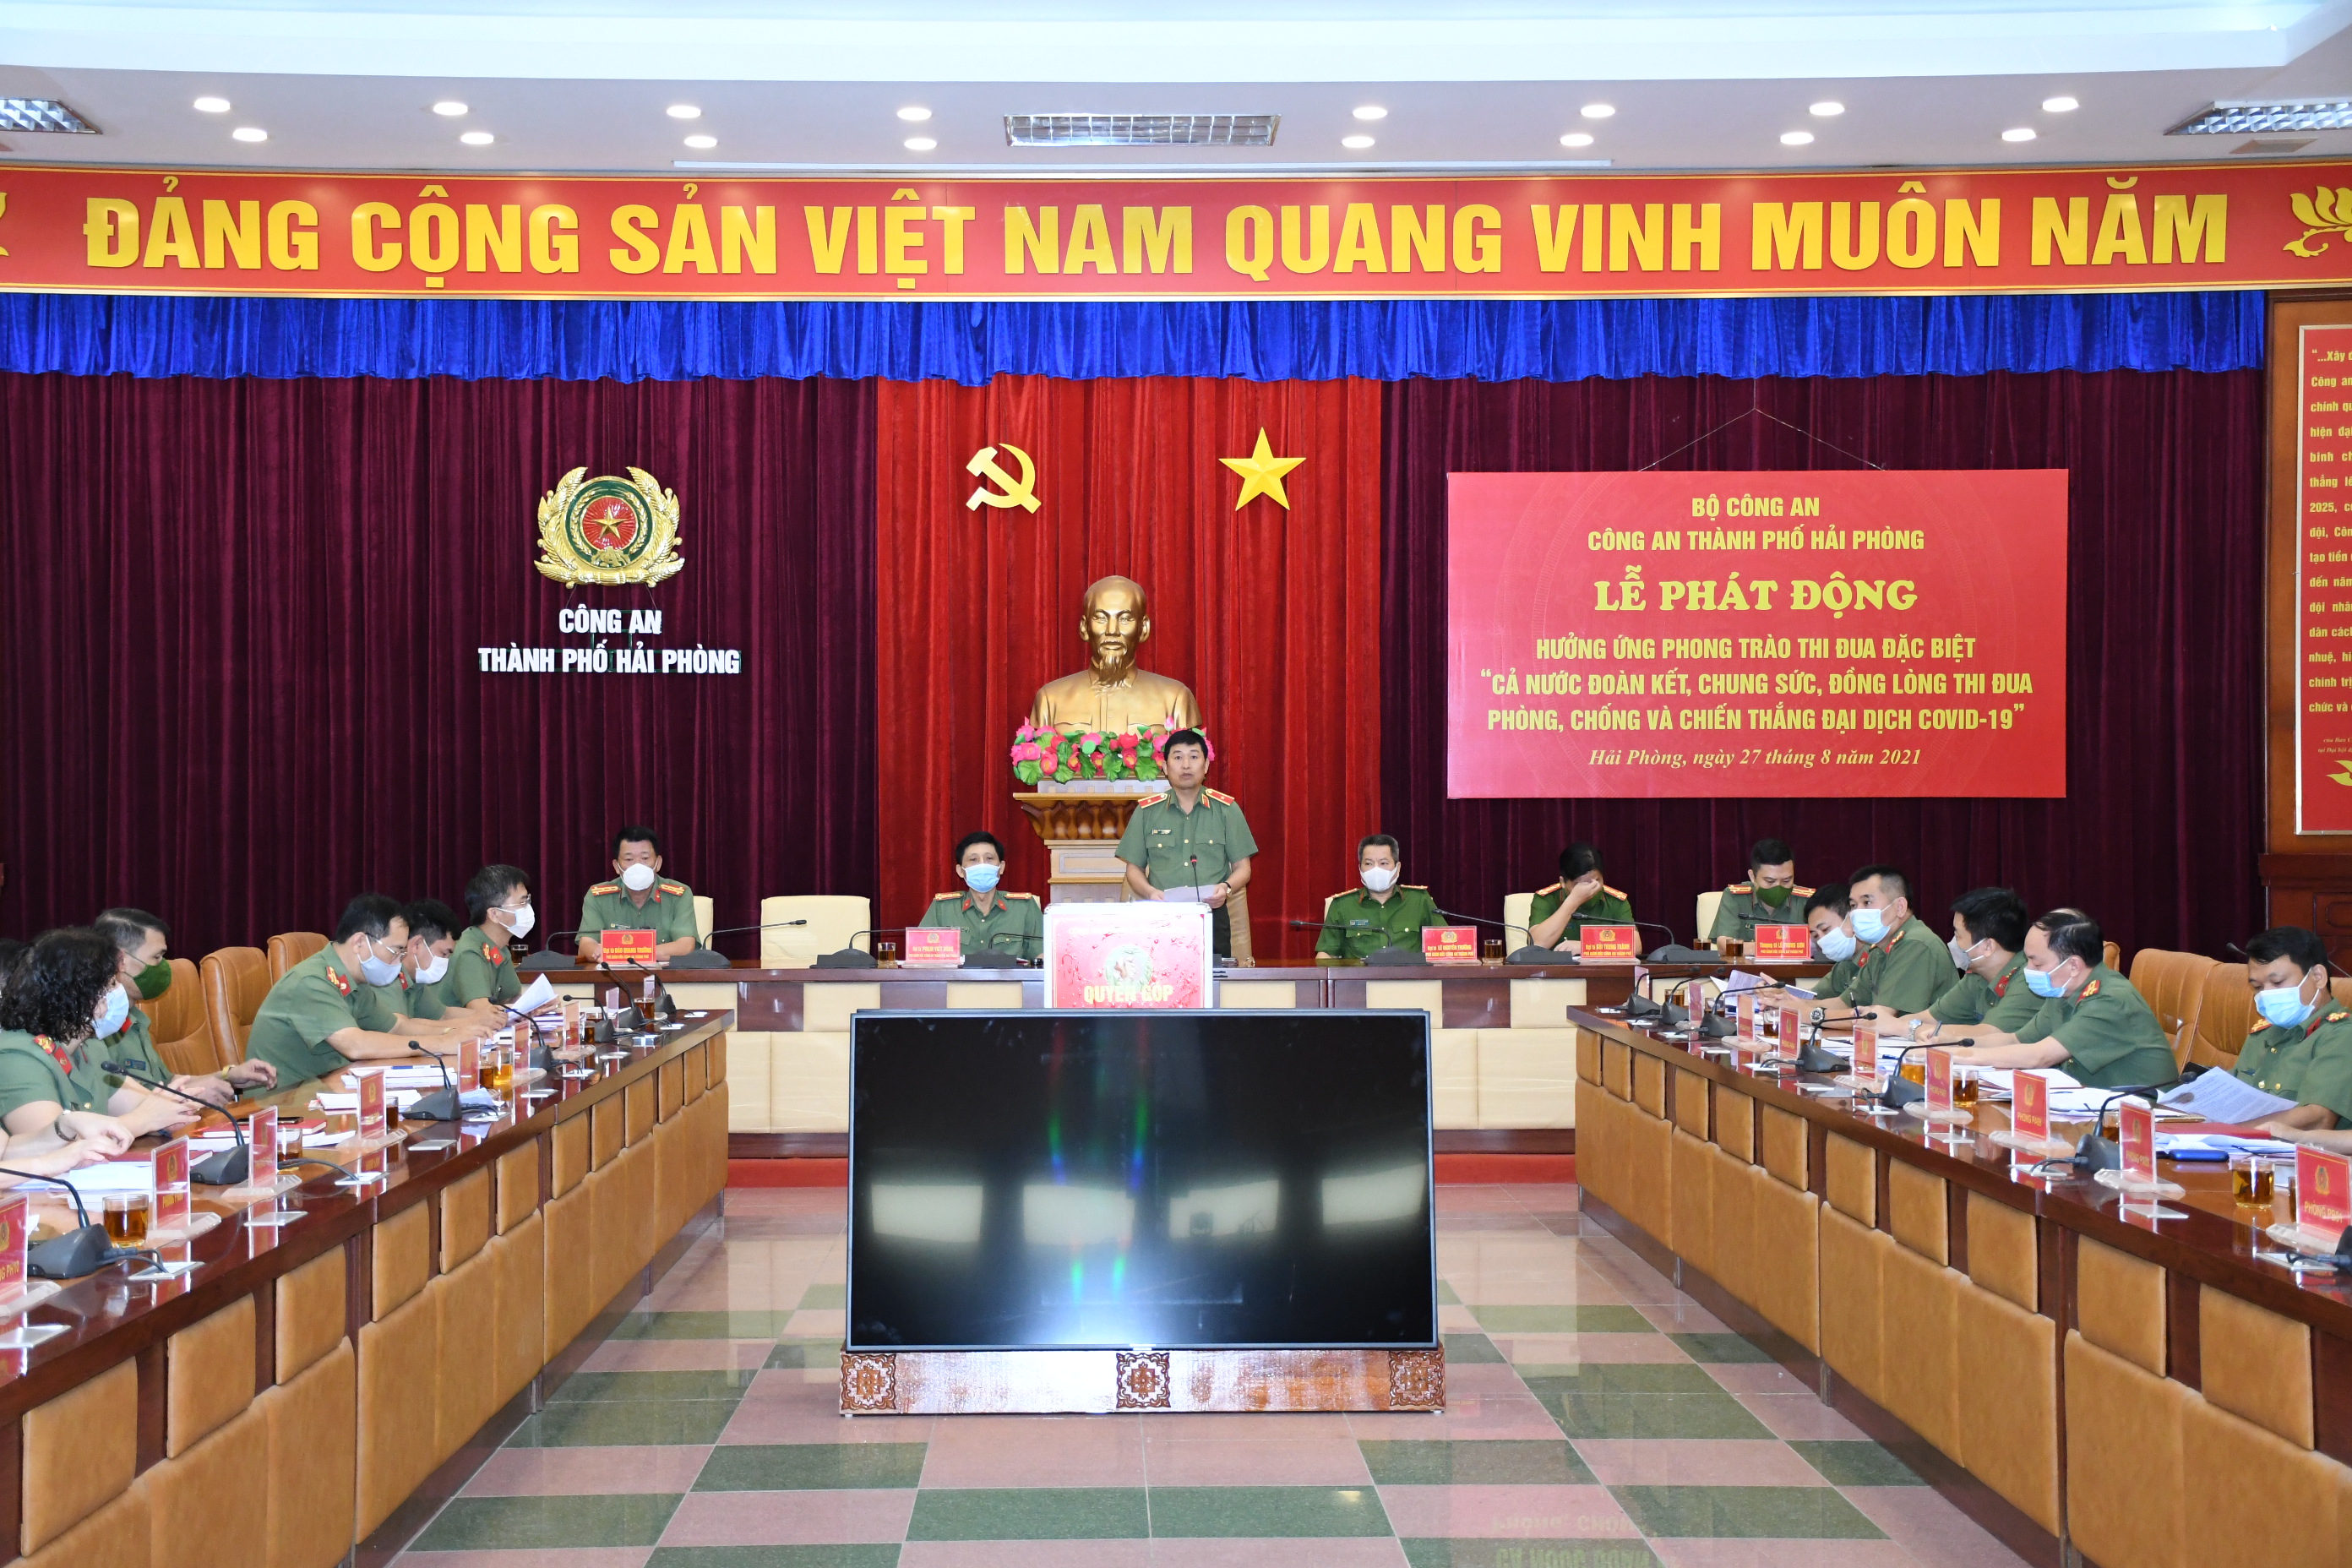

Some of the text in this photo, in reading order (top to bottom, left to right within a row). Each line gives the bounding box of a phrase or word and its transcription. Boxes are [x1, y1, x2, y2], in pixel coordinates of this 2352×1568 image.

[83, 176, 2228, 289] ĐẢNG CỘNG SẢN VIỆT NAM QUANG VINH MUÔN NĂM
[2311, 377, 2337, 387] Công
[2311, 401, 2338, 412] chính
[2311, 427, 2332, 438] hiện
[1693, 494, 1819, 521] BỘ CÔNG AN
[2310, 503, 2337, 513] 2025,
[1588, 524, 1925, 550] CÔNG AN THÀNH PHỐ HẢI PHÒNG
[2310, 527, 2328, 539] đội,
[2310, 553, 2325, 564] tạo
[2310, 575, 2328, 587] đến
[1594, 565, 1918, 618] LỄ PHÁT ĐỘNG
[2310, 602, 2325, 614] đội
[558, 603, 662, 634] CÔNG AN
[1537, 632, 1975, 662] HƯỞNG ỨNG PHONG TRÀO THI ĐUA ĐẶC BIỆT
[477, 639, 740, 674] THÀNH PHỐ HẢI PHÒNG
[2309, 652, 2337, 664] nhuệ,
[1481, 667, 2034, 697] “CẢ NƯỚC ĐOÀN KẾT, CHUNG SỨC, ĐỒNG LÒNG THI ĐUA
[2309, 678, 2337, 687] chính
[2309, 702, 2348, 712] chức và
[1488, 701, 2025, 734] PHÒNG, CHỐNG VÀ CHIẾN THẮNG ĐẠI DỊCH COVID-19”
[1589, 749, 1921, 768] Hải Phòng, ngày 27 tháng 8 năm 2021
